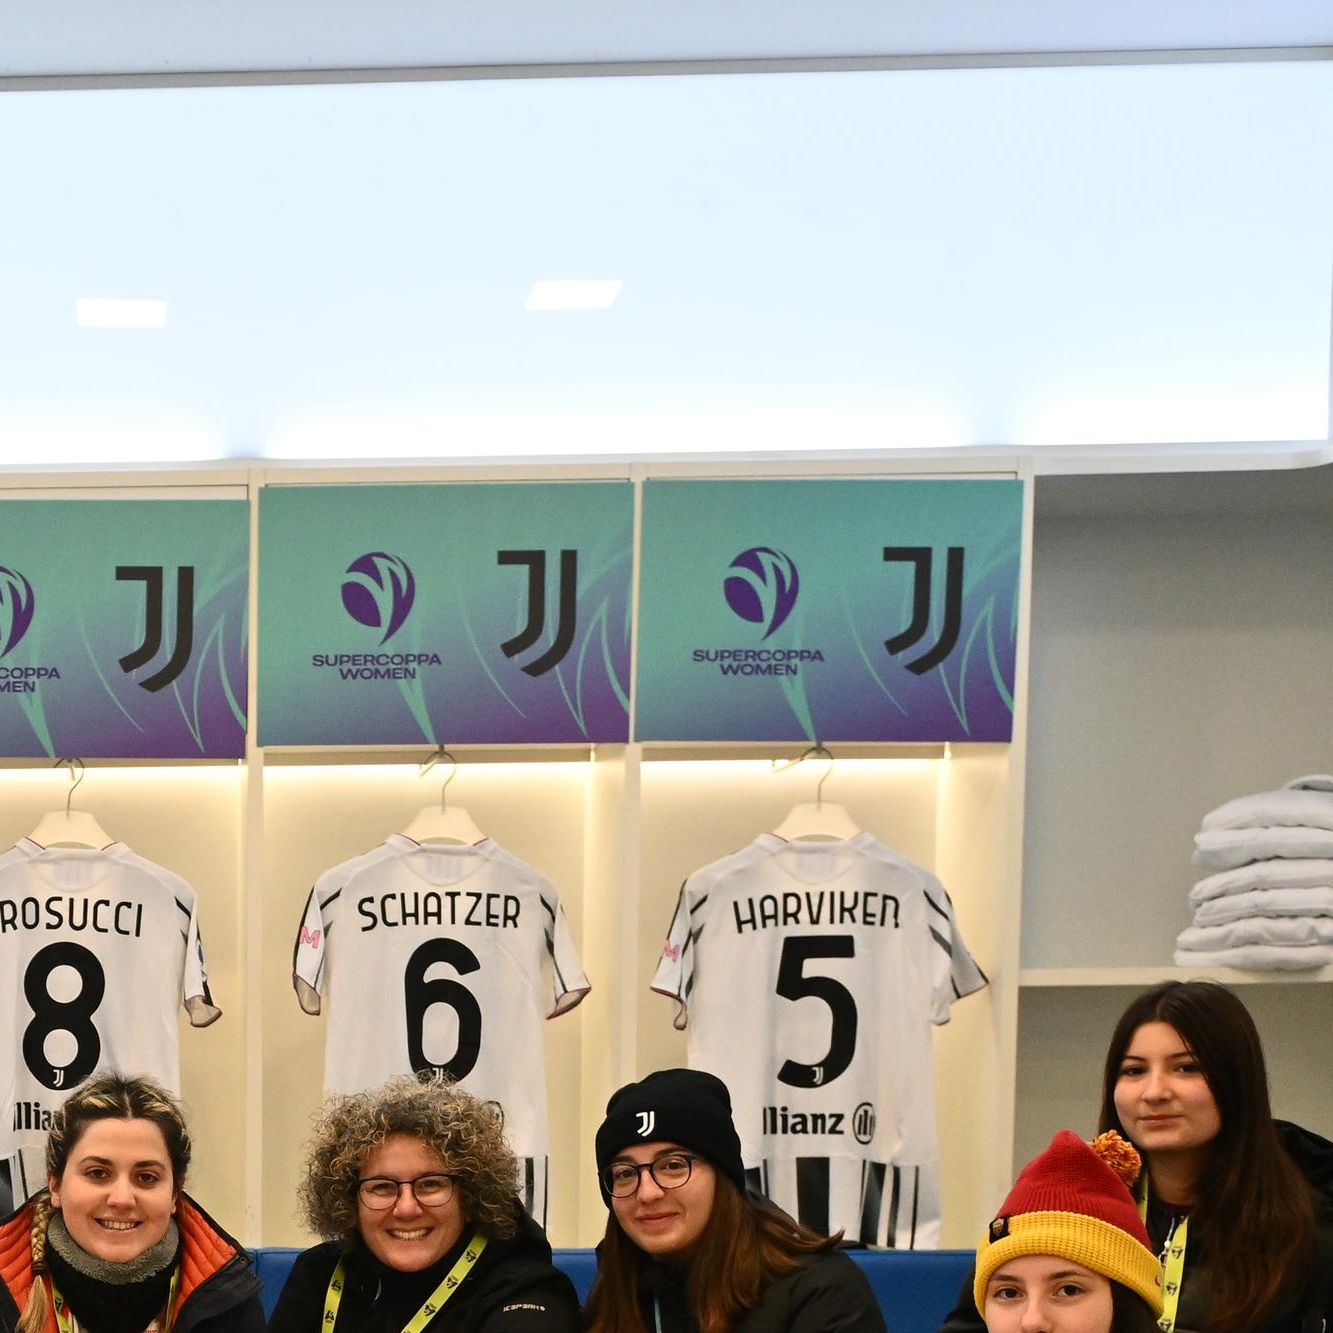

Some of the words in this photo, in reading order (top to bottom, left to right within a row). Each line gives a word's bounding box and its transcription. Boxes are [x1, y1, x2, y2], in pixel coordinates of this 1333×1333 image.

[312, 653, 442, 667] SUPERCOPPA
[339, 667, 416, 680] WOMEN
[692, 649, 825, 662] SUPERCOPPA
[720, 663, 798, 676] WOMEN
[357, 891, 521, 932] SCHATZER
[733, 891, 900, 934] HARVIKEN
[22, 941, 105, 1091] 8
[404, 938, 482, 1086] 6
[776, 934, 858, 1088] 5
